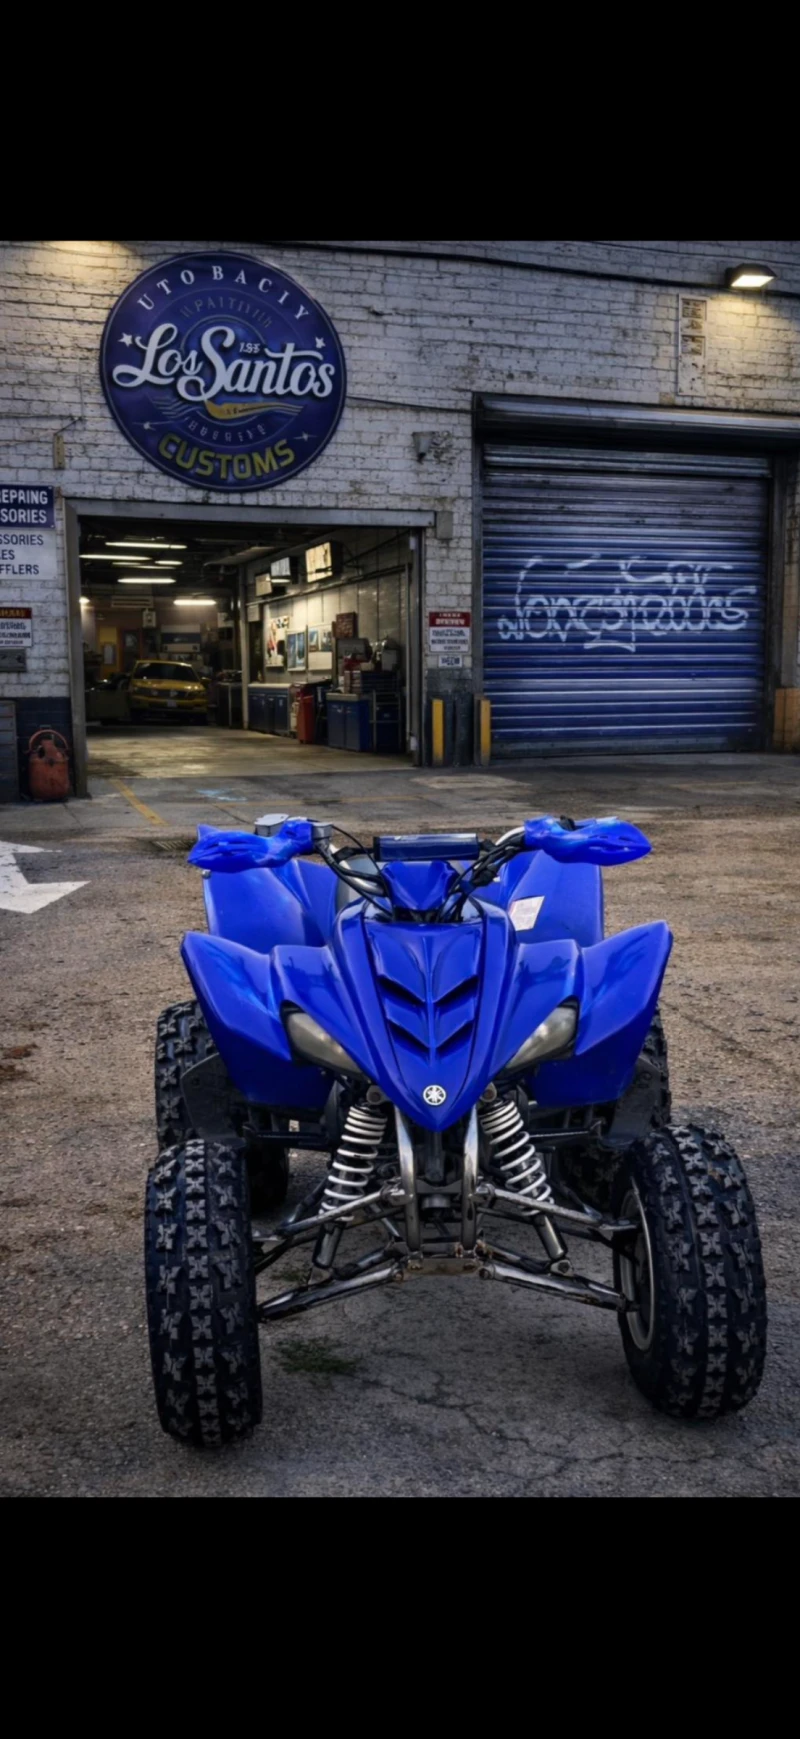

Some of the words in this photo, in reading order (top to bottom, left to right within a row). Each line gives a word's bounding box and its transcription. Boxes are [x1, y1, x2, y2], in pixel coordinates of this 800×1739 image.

[112, 323, 202, 387] Los
[177, 326, 335, 402] Santos
[158, 433, 295, 480] CUSTOMS
[0, 508, 47, 524] SORIES
